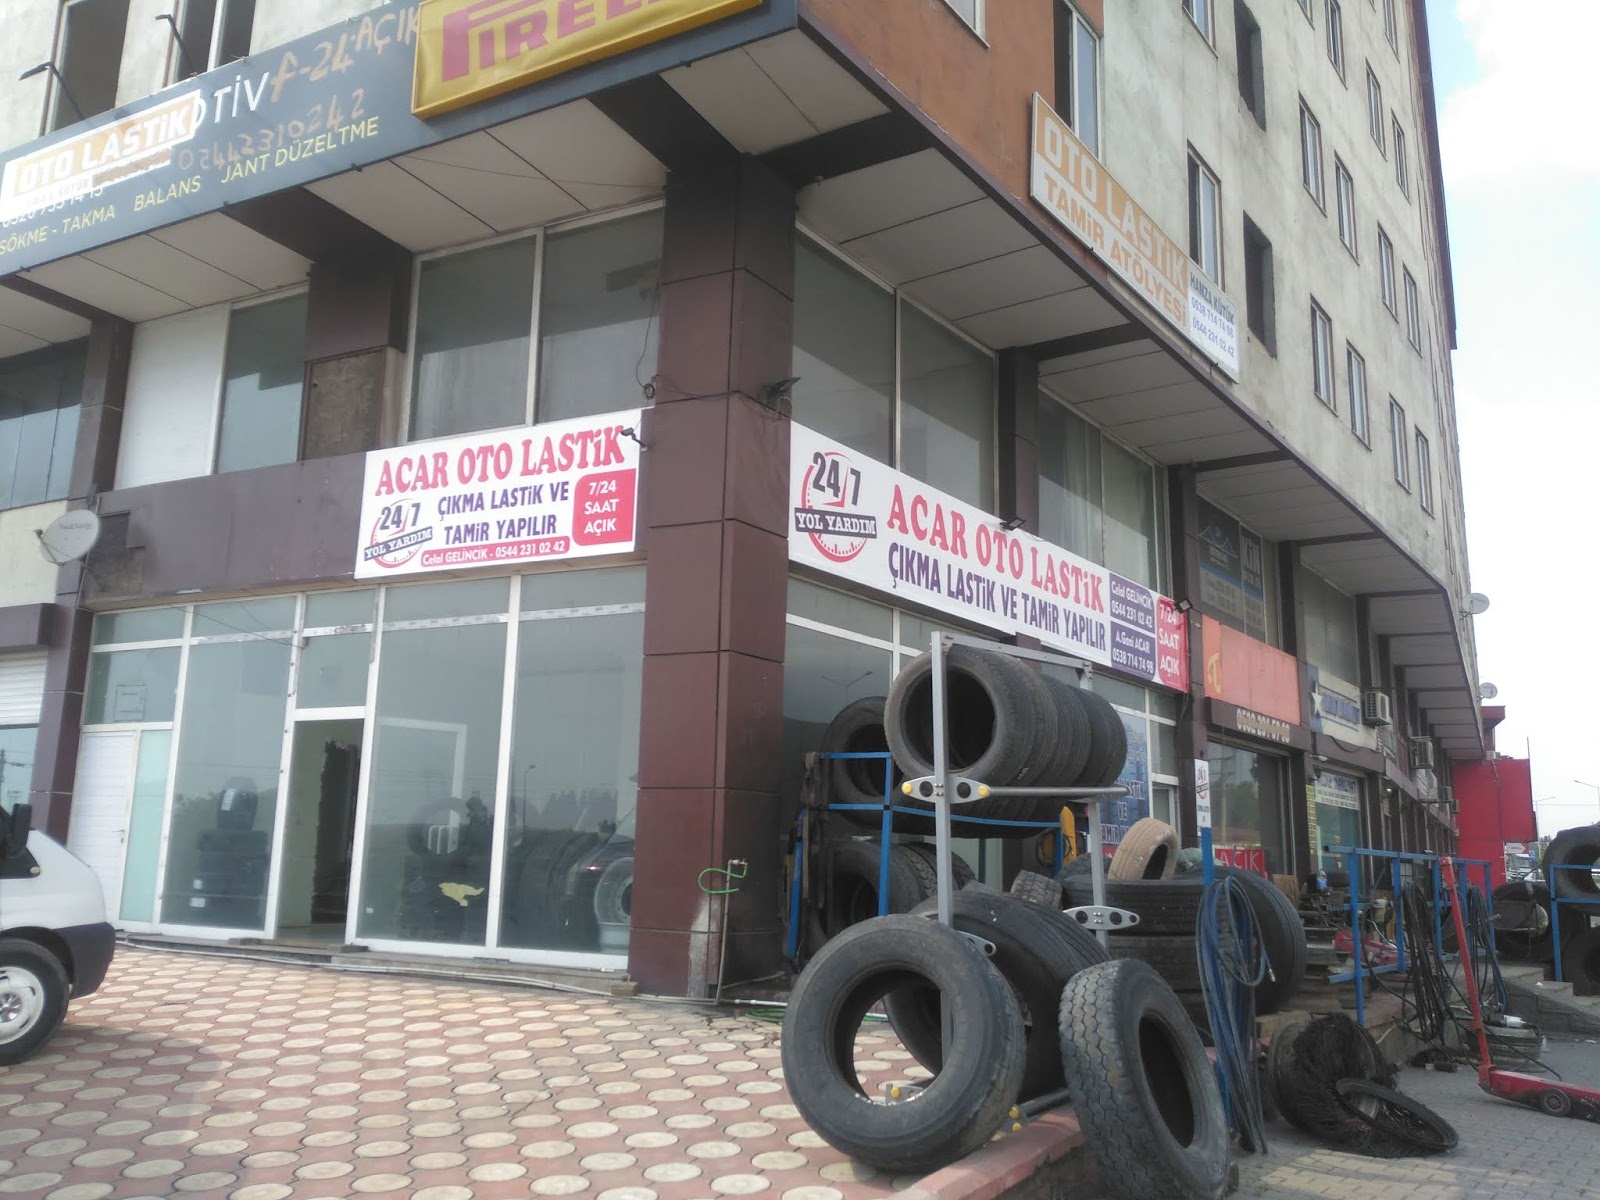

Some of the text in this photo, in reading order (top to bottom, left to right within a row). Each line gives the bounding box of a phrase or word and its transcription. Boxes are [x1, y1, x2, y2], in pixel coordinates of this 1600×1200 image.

[20, 104, 191, 193] OTO LASTİK
[0, 225, 48, 255] SÖKME
[62, 204, 116, 234] TAKMA
[133, 175, 201, 212] BALANS
[221, 153, 271, 184] JANT
[275, 116, 380, 166] DÜZELTME
[1044, 116, 1186, 295] OTO LASTİK
[1044, 172, 1187, 328] TAMİR ATÖLYESİ
[1190, 271, 1213, 308] HAMZA
[375, 425, 625, 496] ACAR OTO LASTİK
[437, 481, 570, 521] ÇIKMA LASTİK VE
[588, 479, 617, 497] 7/24
[584, 498, 619, 515] SAAT
[443, 514, 557, 546] TAMİR YAPILIR
[583, 517, 617, 537] AÇIK
[795, 510, 876, 537] YOL YARDIM
[365, 528, 432, 561] YOL YARDIM
[422, 552, 444, 566] Celal
[445, 547, 488, 563] GELİNCİK
[495, 544, 519, 560] 0544
[519, 543, 537, 557] 231
[538, 541, 551, 555] 02
[551, 540, 566, 554] 42
[886, 484, 1105, 614] ACAR OTO LASTİK
[887, 541, 1106, 653] ÇIKMA LASTİK VE TAMİR YAPILIR
[1111, 580, 1153, 610] Celal GELİNCİK
[1111, 600, 1153, 628] 0544 231 02 42
[1134, 637, 1151, 655] ACAR
[1158, 628, 1179, 650] SAAT
[1112, 648, 1154, 674] 0538 714 74 98
[1160, 655, 1180, 678] AÇIK
[1116, 801, 1128, 821] VE
